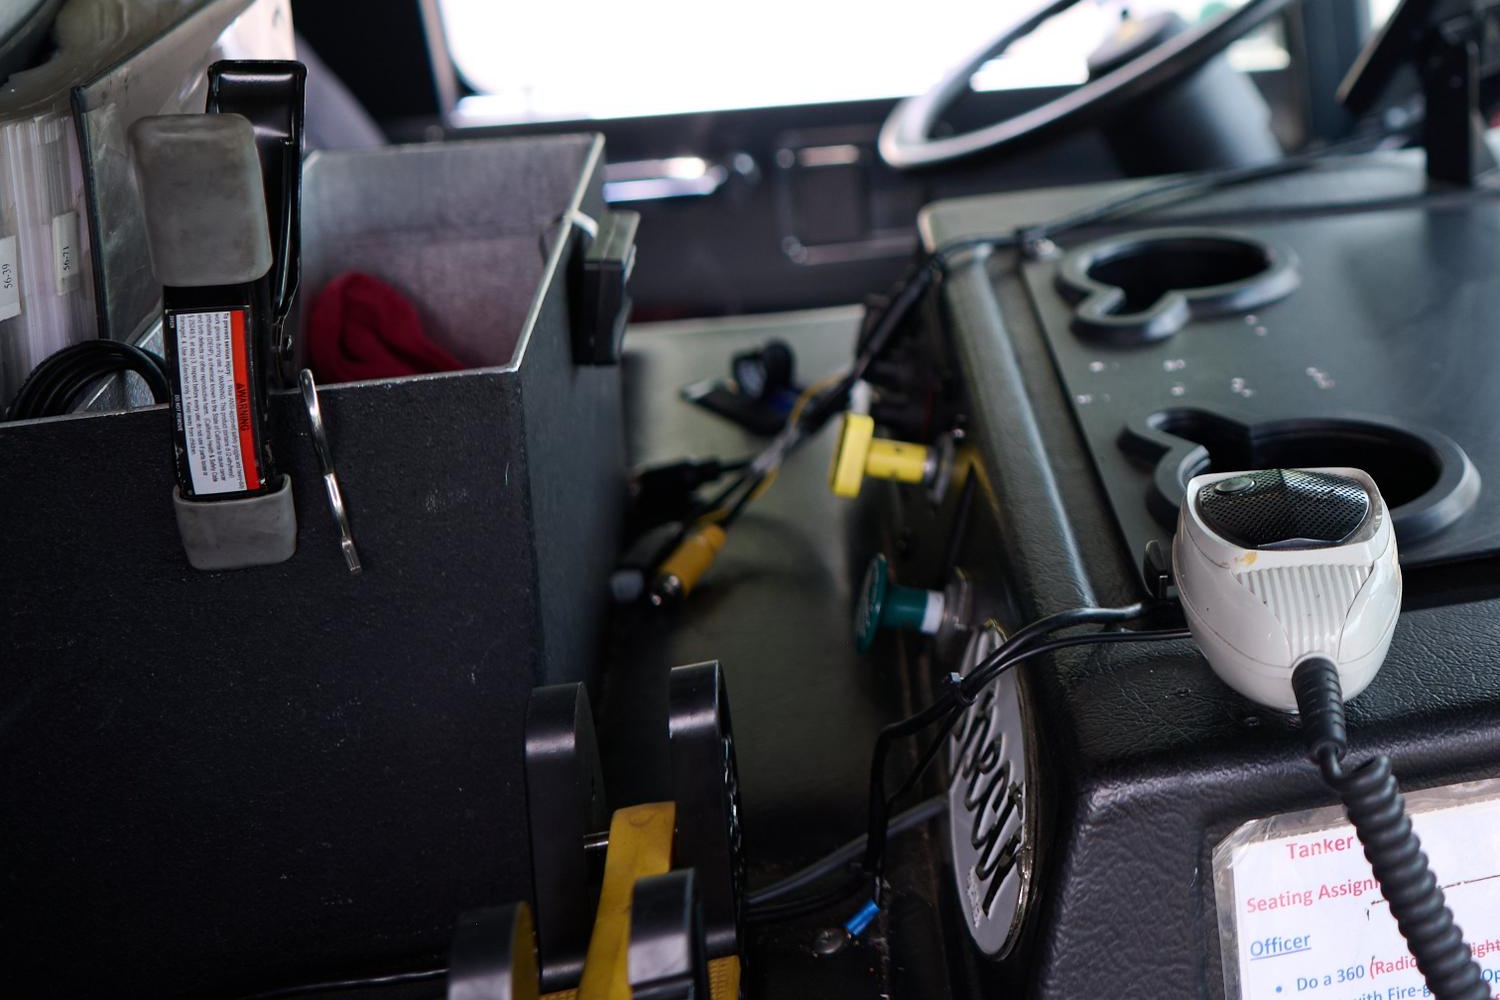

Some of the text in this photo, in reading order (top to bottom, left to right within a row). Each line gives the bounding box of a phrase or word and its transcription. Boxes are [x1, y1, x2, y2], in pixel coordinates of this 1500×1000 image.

[236, 389, 249, 431] WARNING
[1286, 835, 1354, 860] Tanker
[1247, 878, 1381, 914] Seating Assign
[1250, 934, 1311, 959] Officer
[1297, 977, 1319, 992] Do
[1323, 975, 1332, 986] a
[1337, 964, 1365, 983] 360
